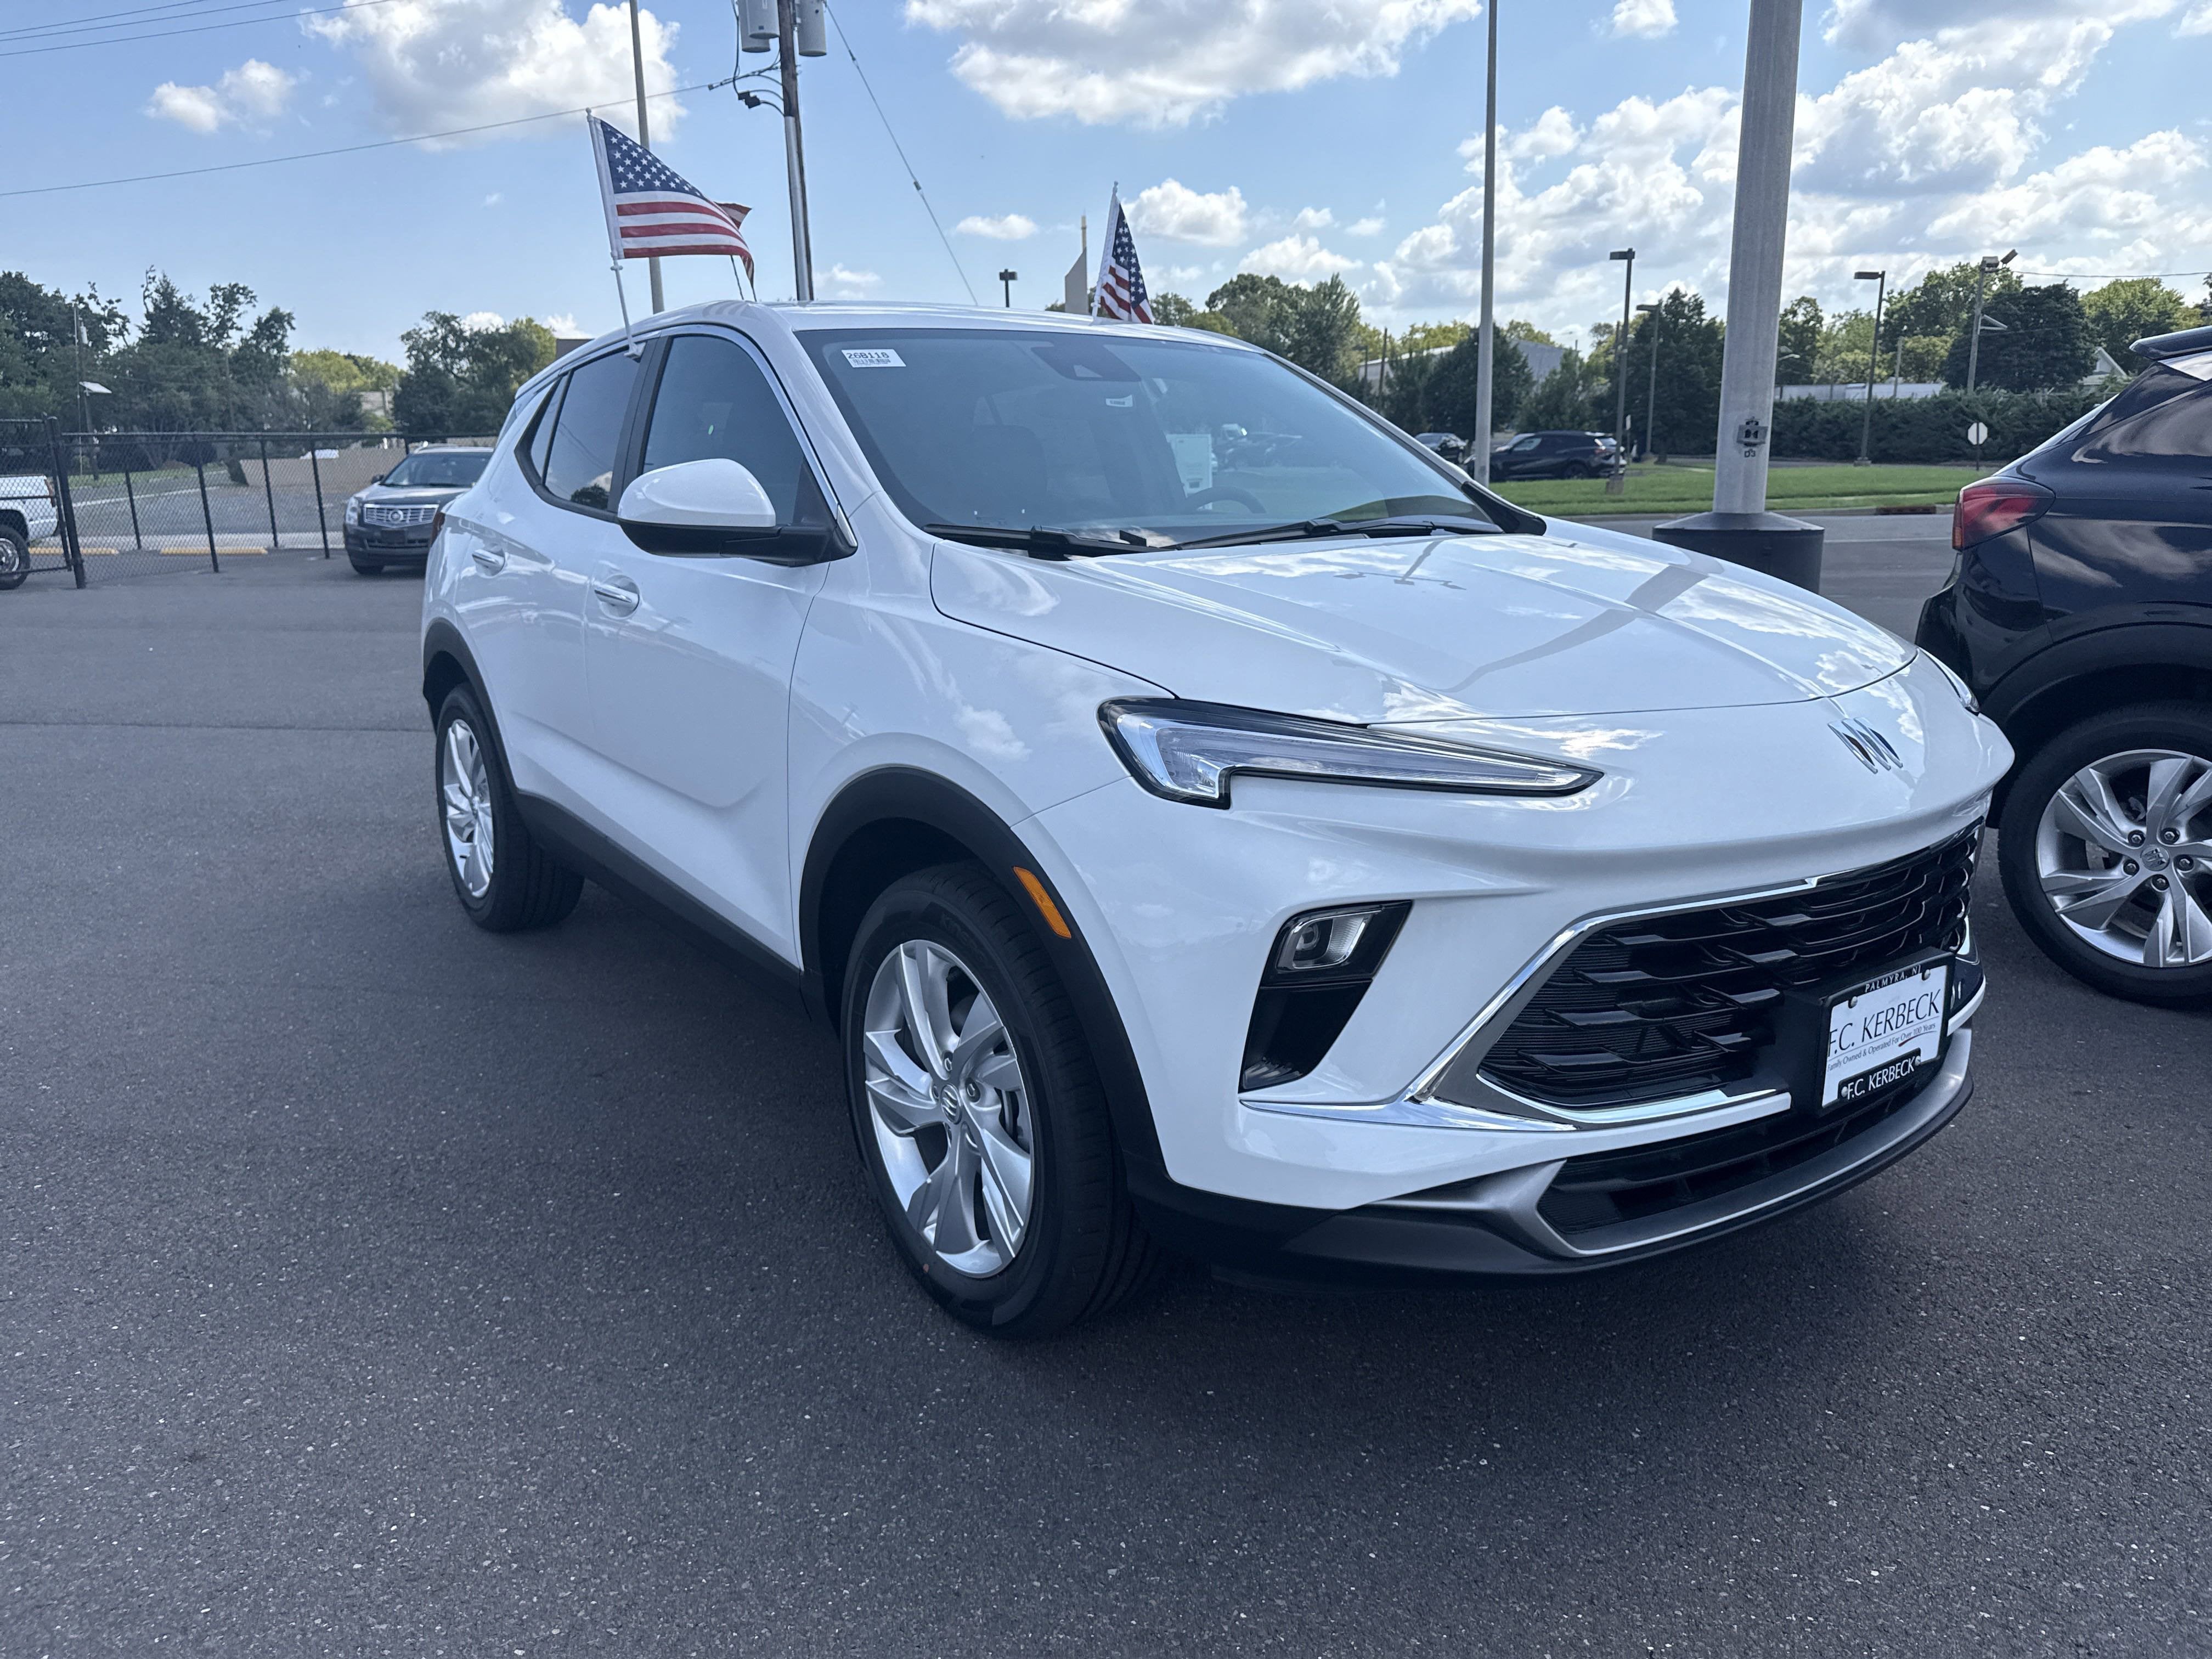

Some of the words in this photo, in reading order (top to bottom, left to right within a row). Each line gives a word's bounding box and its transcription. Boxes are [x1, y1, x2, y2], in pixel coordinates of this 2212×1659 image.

[1827, 1023, 1854, 1057] F.C.
[1861, 989, 1941, 1042] KERBECK
[1827, 1058, 1843, 1072] Family
[1843, 1051, 1862, 1064] Owned
[1863, 1048, 1867, 1057] &
[1868, 1040, 1892, 1054] Operated
[1892, 1036, 1900, 1045] For
[1900, 1031, 1912, 1041] Over
[1923, 1023, 1936, 1032] Years
[1847, 1078, 1865, 1099] F.C.
[1869, 1056, 1915, 1091] KERBECK
